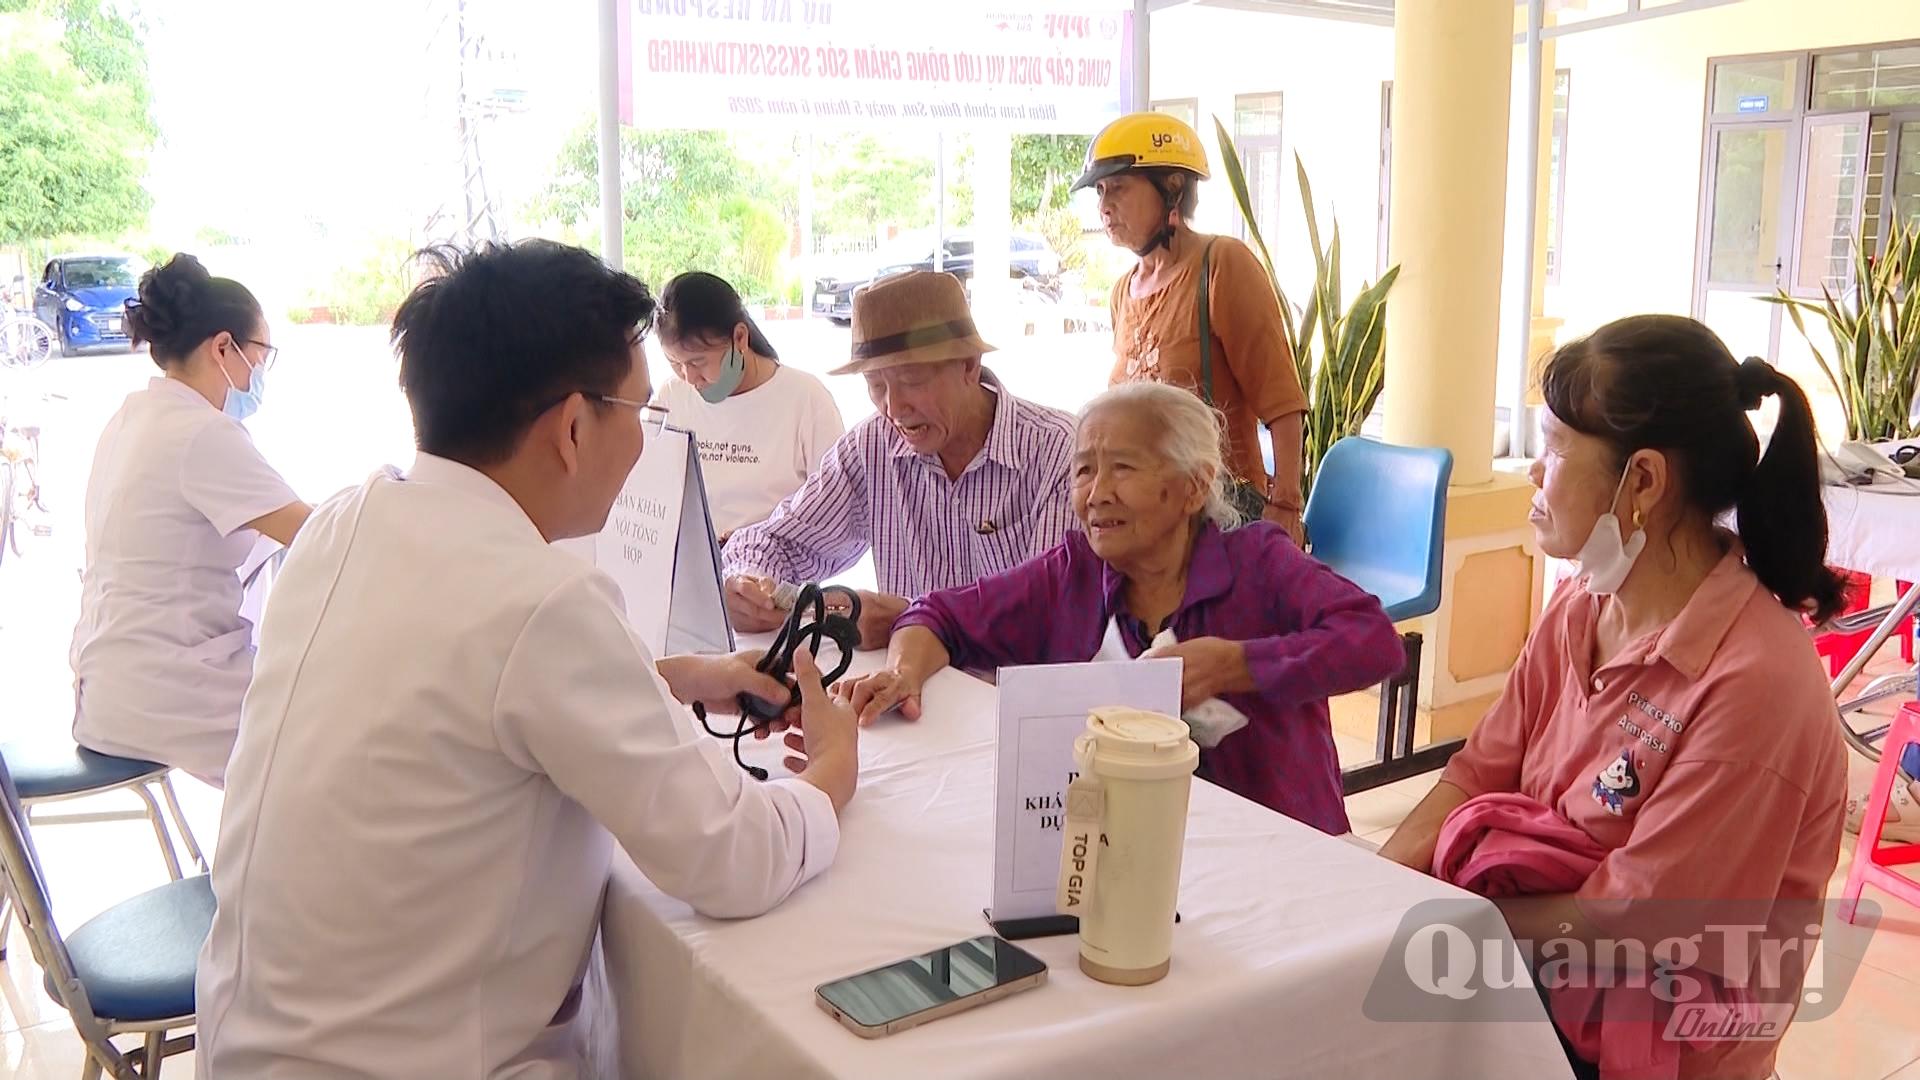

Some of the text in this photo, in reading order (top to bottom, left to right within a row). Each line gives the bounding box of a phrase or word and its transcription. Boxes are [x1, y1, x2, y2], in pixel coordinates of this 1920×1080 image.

[1025, 791, 1064, 810] KHÁ
[1067, 833, 1088, 907] TOP GIA
